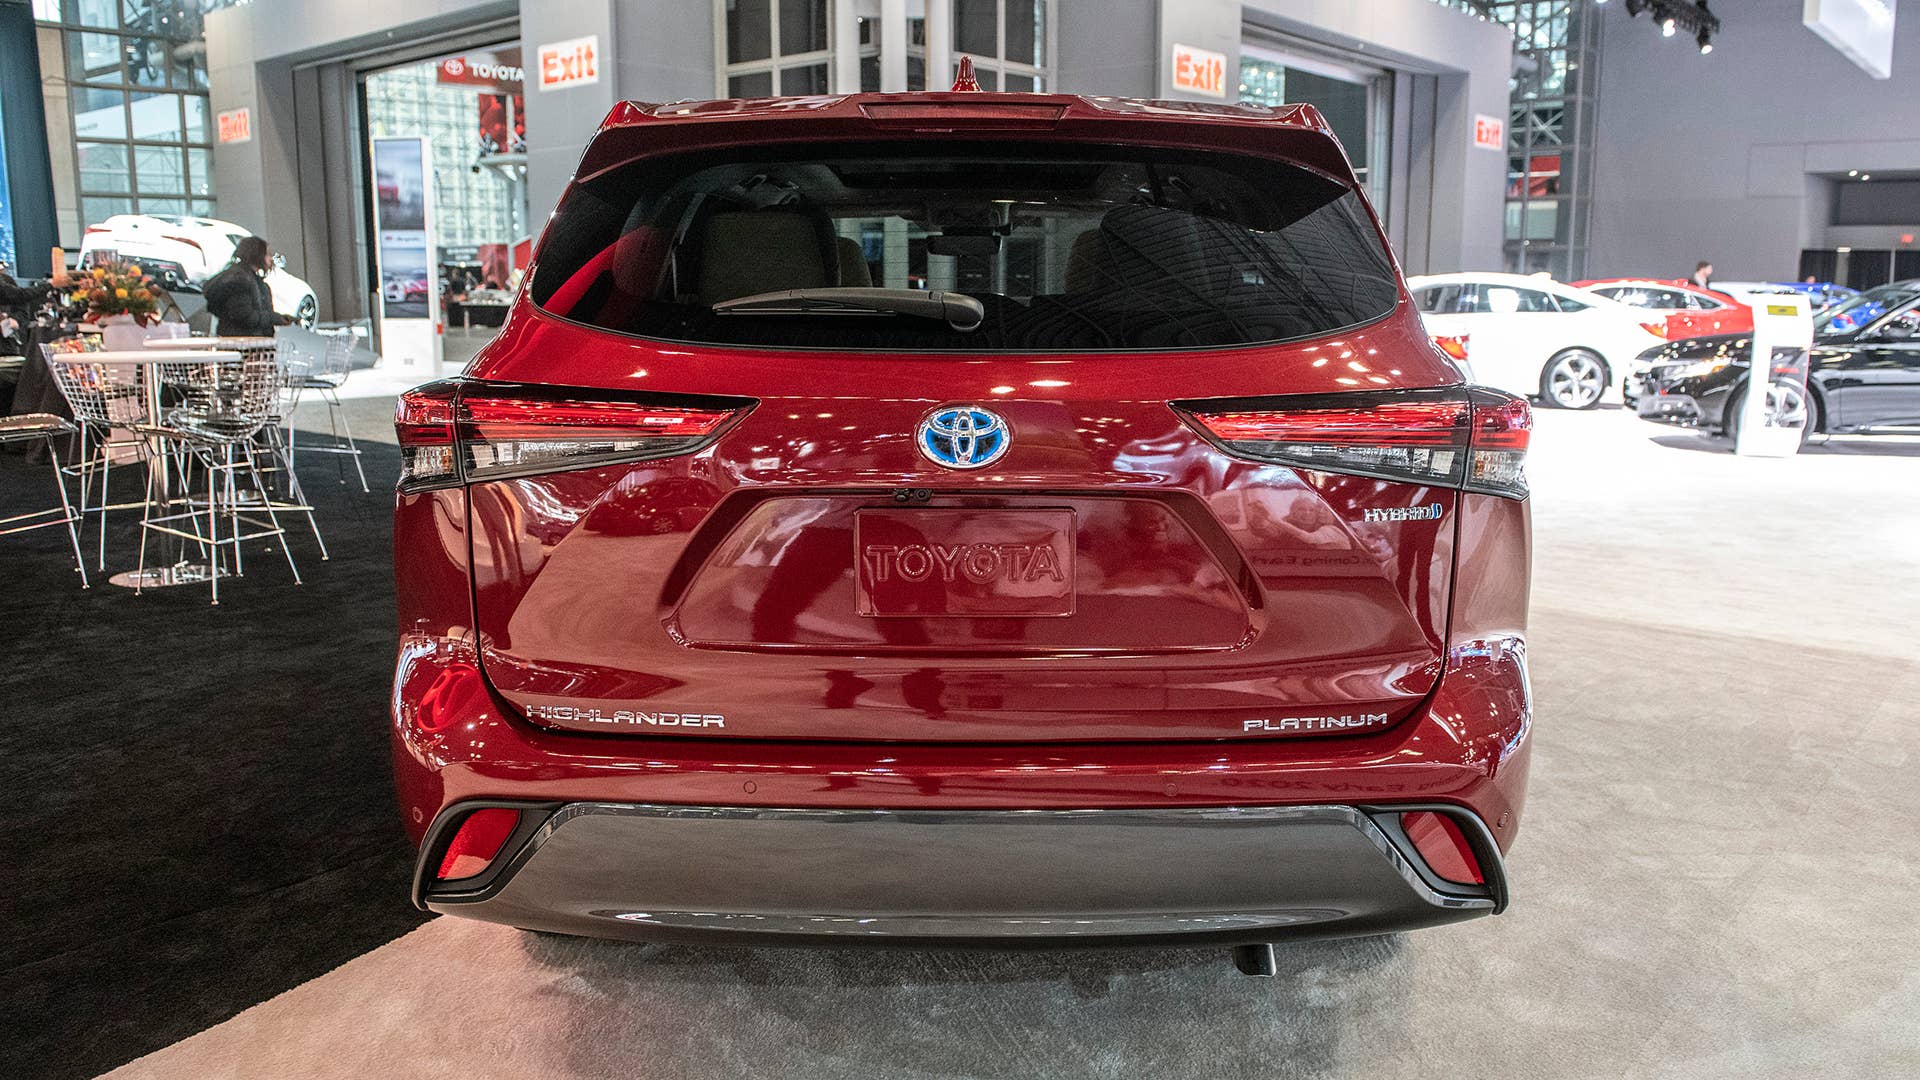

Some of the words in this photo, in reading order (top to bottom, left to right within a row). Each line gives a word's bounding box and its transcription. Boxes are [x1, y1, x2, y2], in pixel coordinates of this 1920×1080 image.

[471, 62, 525, 82] TOYOTA
[542, 44, 596, 85] Exit
[1175, 53, 1223, 93] Exit
[865, 543, 1065, 584] TOYOTA
[526, 704, 726, 728] HIGHLANDER
[1243, 713, 1388, 732] PLATINUM
